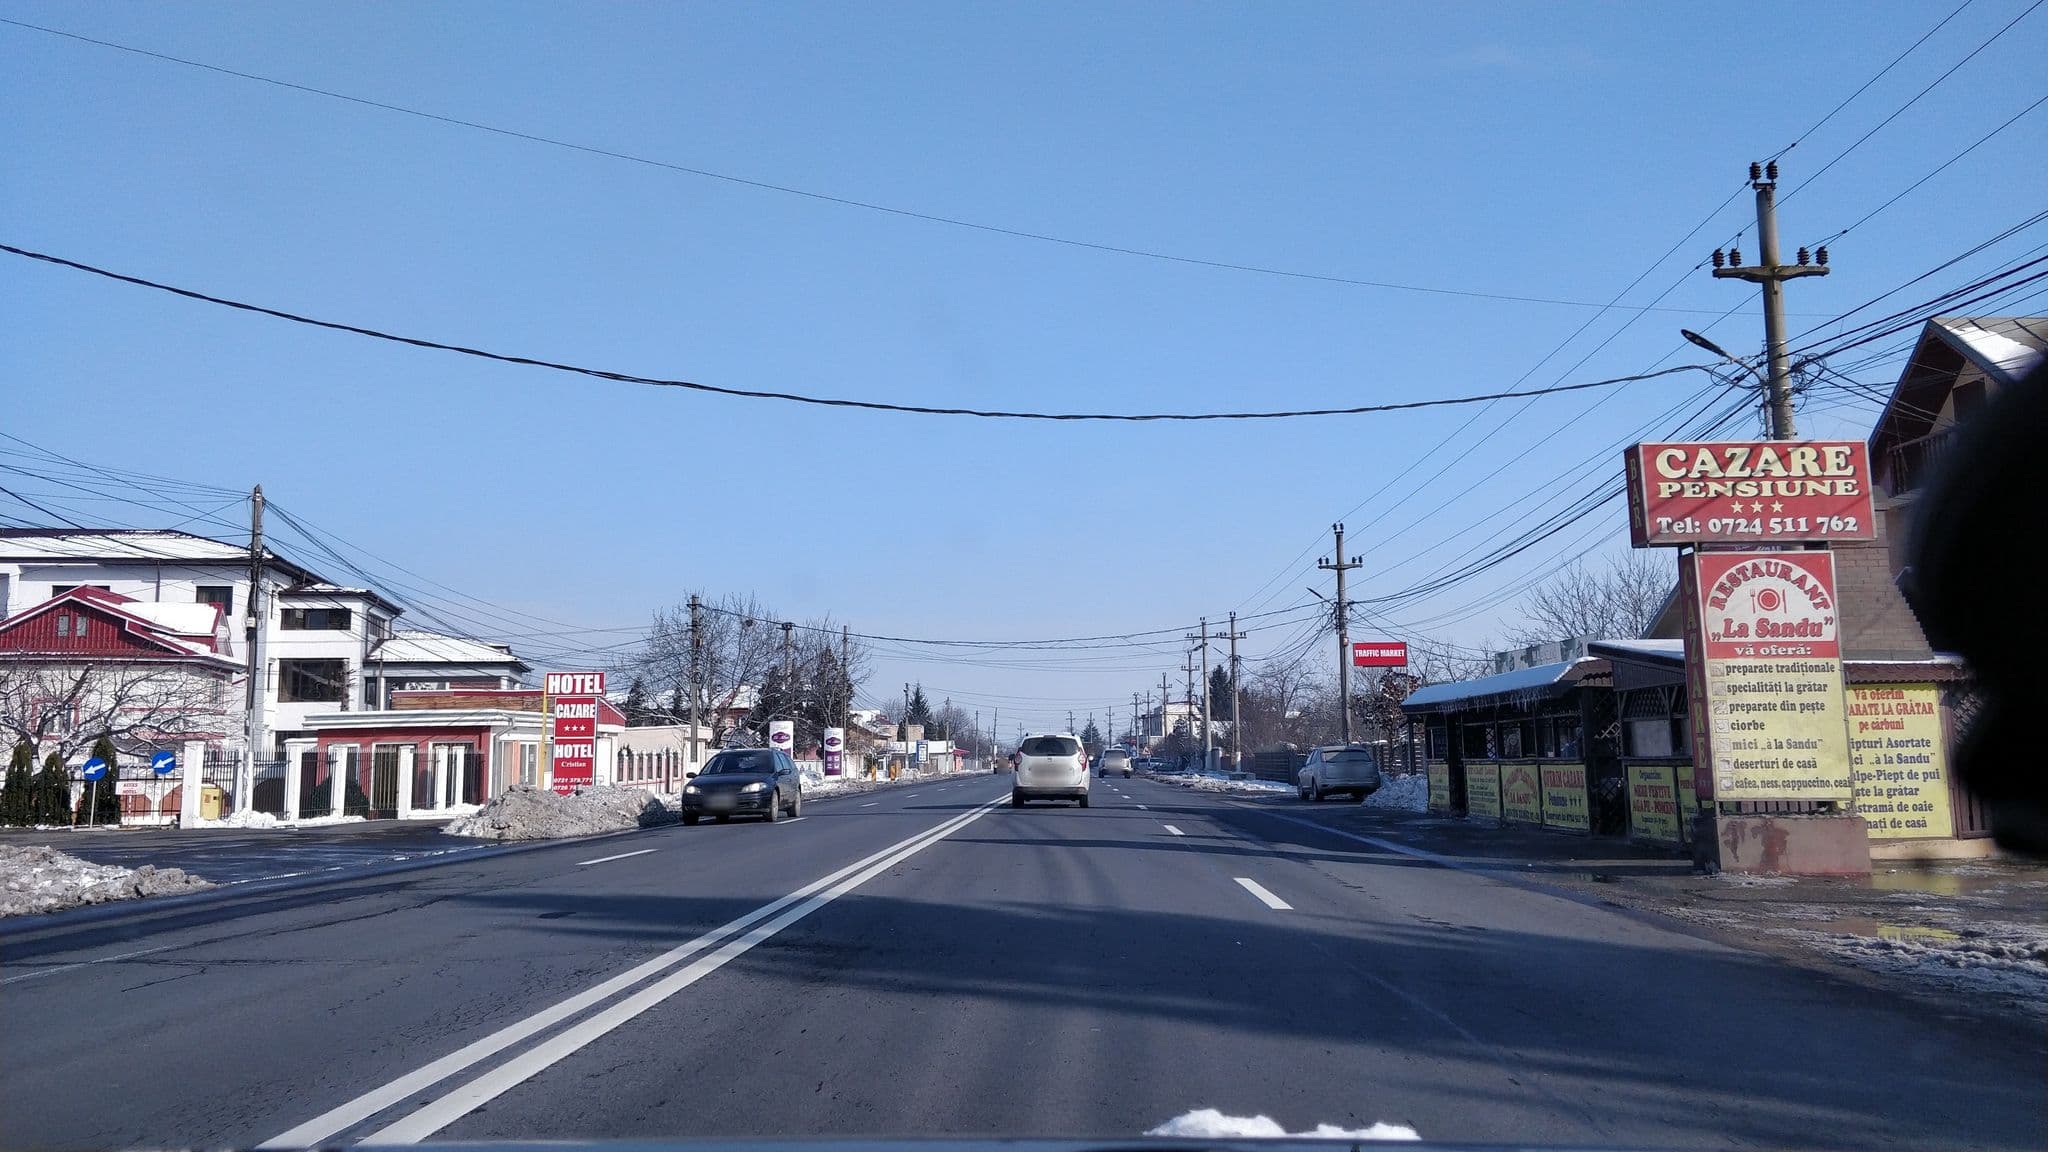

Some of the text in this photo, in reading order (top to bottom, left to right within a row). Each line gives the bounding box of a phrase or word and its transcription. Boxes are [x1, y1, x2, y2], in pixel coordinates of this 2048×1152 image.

[1656, 446, 1855, 479] CAZARE
[1630, 458, 1643, 529] BAR
[1657, 479, 1860, 498] PENSIUNE
[1657, 516, 1858, 534] Tel: 0724 511 762
[1709, 561, 1831, 611] RESTAURANT
[1355, 649, 1405, 657] TRAFFIC MARKET
[1735, 644, 1812, 655] vă oferă:
[1725, 662, 1835, 676] preparate tradiționale
[547, 674, 602, 694] HOTEL
[1727, 681, 1828, 696] specialități la grătar
[1870, 688, 1904, 700] oferim
[556, 703, 596, 718] CAZARE
[1729, 701, 1826, 714] preparate din pește
[1846, 703, 1880, 716] ARATE
[1882, 703, 1894, 715] LA
[1731, 720, 1765, 730] ciorbe
[1859, 721, 1869, 733] pe
[555, 743, 594, 758] HOTEL
[1732, 739, 1758, 750] mici
[1774, 739, 1784, 750] la
[1850, 737, 1931, 751] ipturi Asortate
[1734, 757, 1818, 769] deserturi de casă
[1884, 753, 1894, 764] la
[1907, 769, 1920, 780] de
[1922, 768, 1940, 783] pui
[1735, 778, 1760, 790] cafea,
[1855, 785, 1920, 801] ște la grătar
[1897, 801, 1908, 812] de
[1912, 801, 1934, 812] oaie
[1867, 817, 1927, 833] nați de casă
